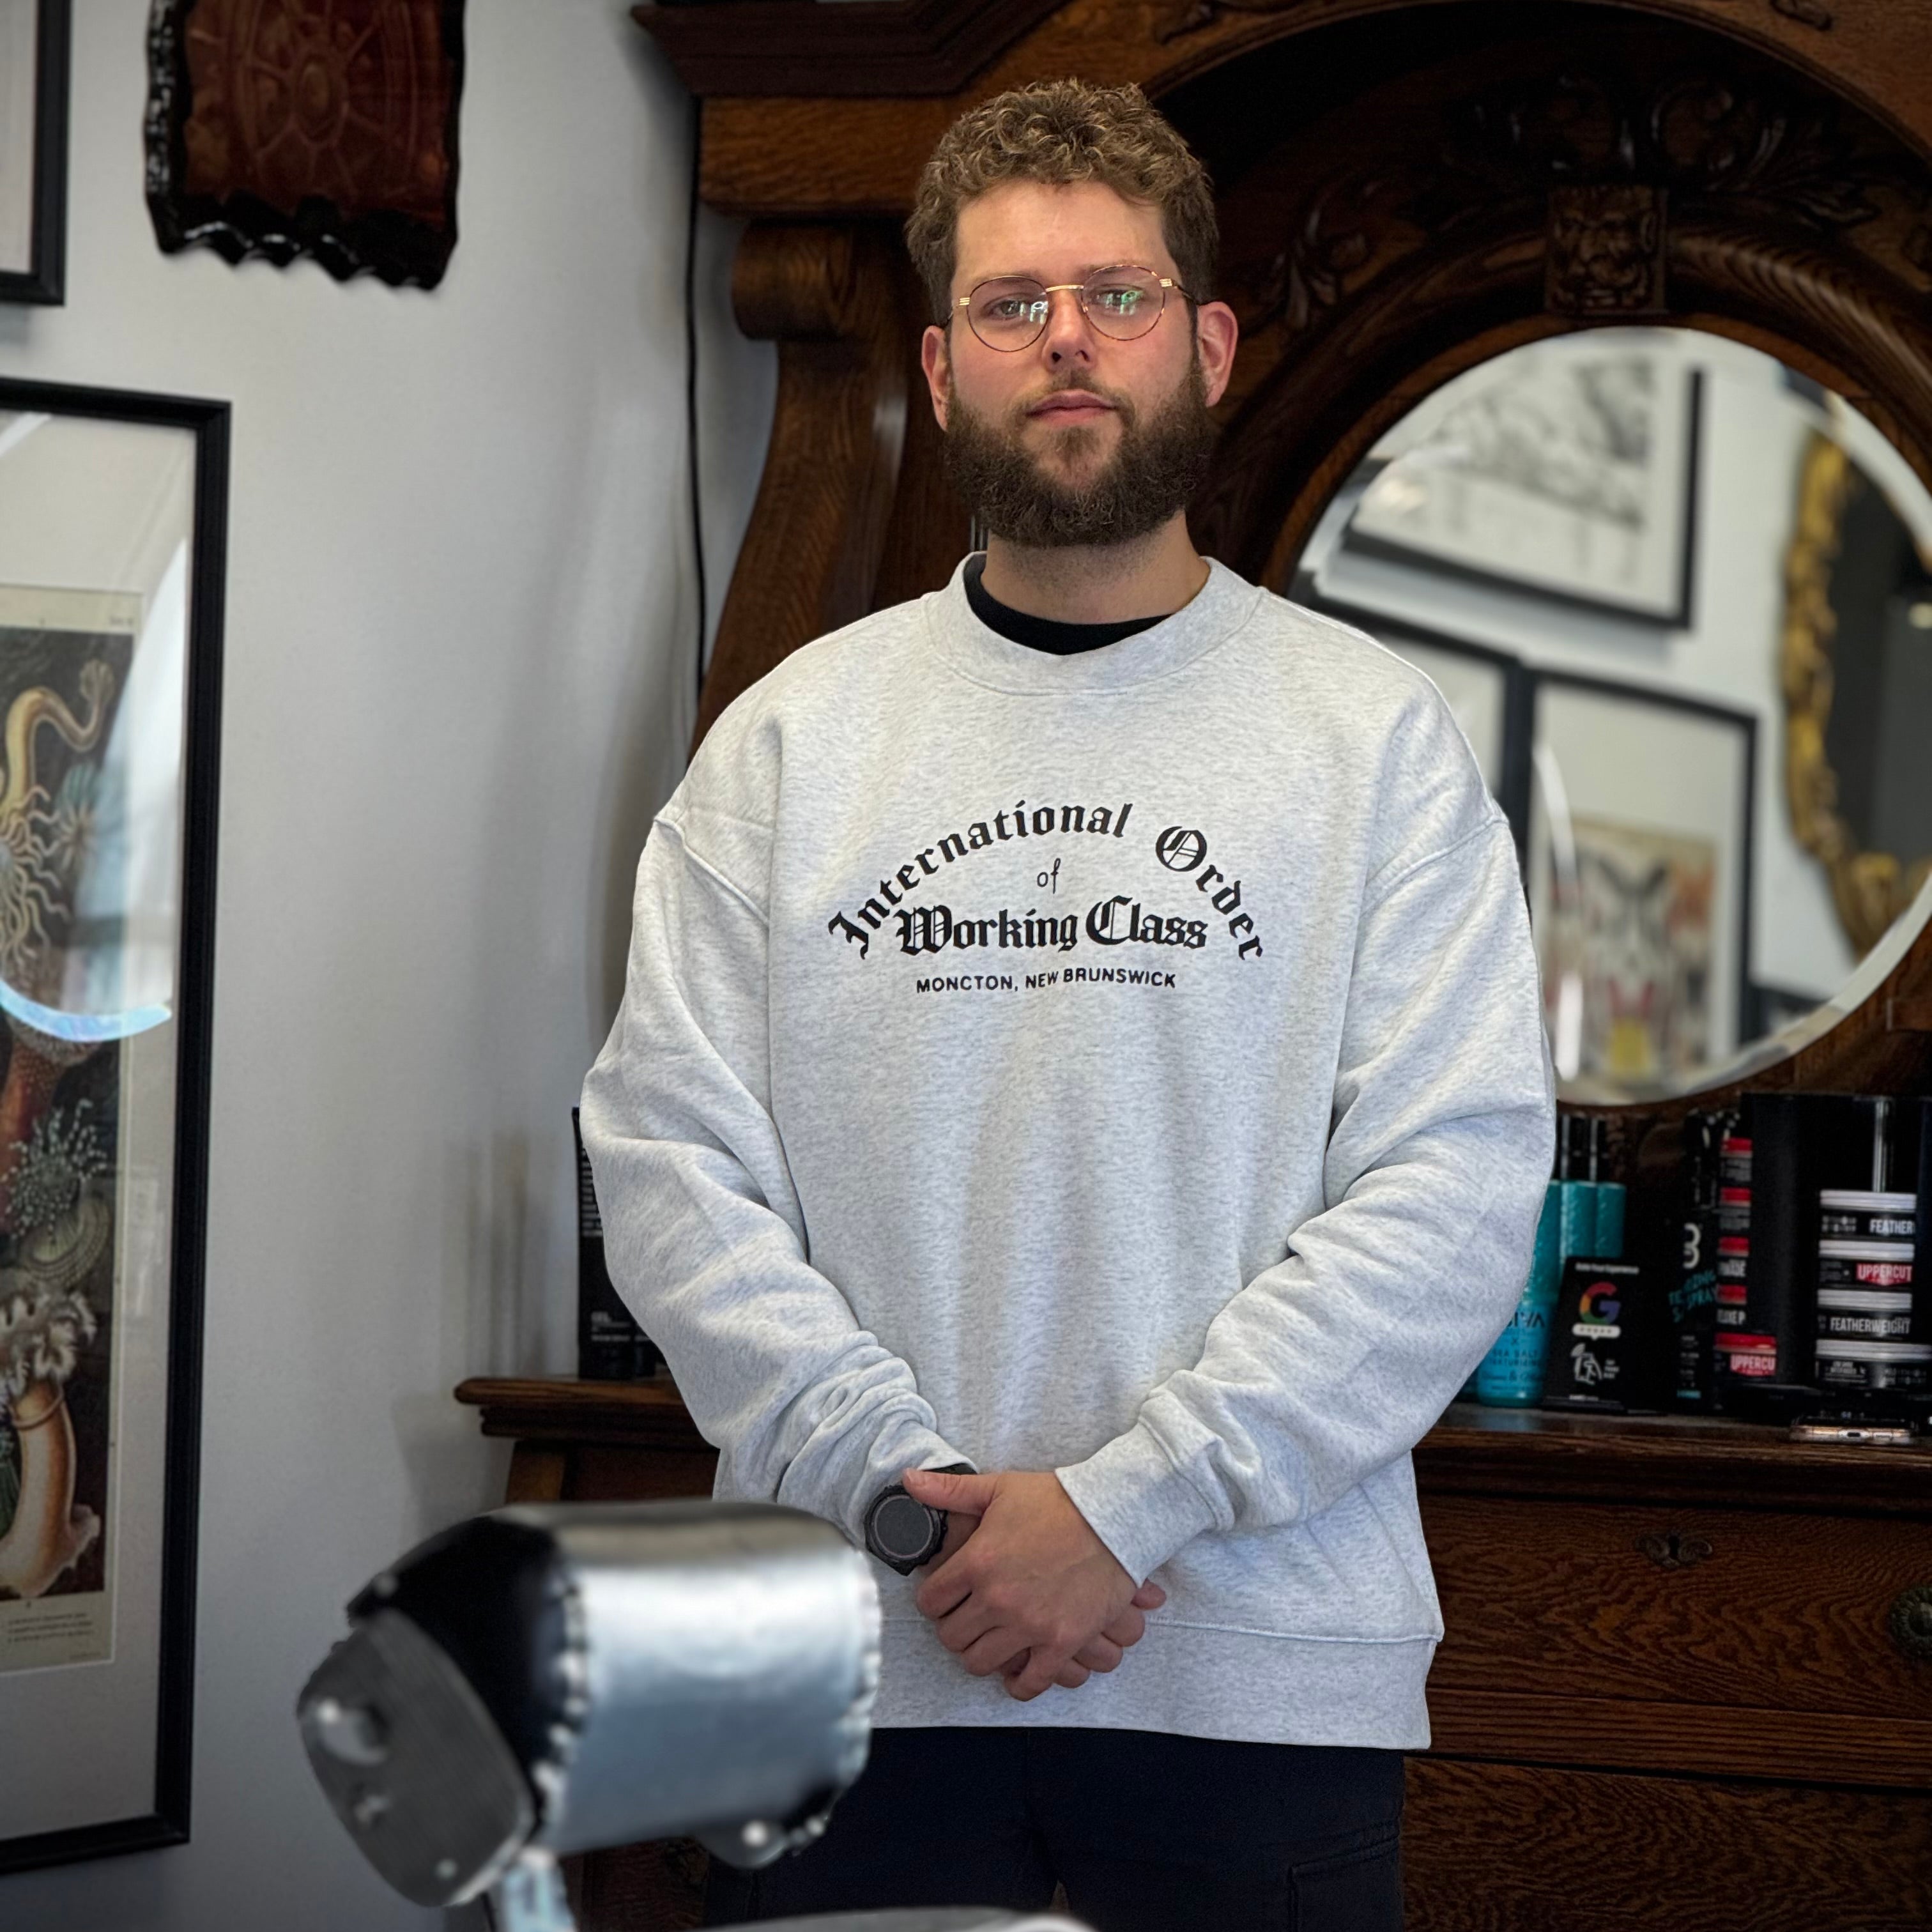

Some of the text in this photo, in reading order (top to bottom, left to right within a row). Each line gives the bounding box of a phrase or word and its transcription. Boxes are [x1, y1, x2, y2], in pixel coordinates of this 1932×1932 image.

[828, 800, 1264, 961] International Order
[1036, 858, 1062, 894] of
[893, 895, 1208, 956] Working Class
[915, 967, 1177, 994] MONCTON, NEW BRUNSWICK
[1857, 1263, 1913, 1283] UPPERCUT
[1830, 1316, 1911, 1335] FEATHERWEIGHT
